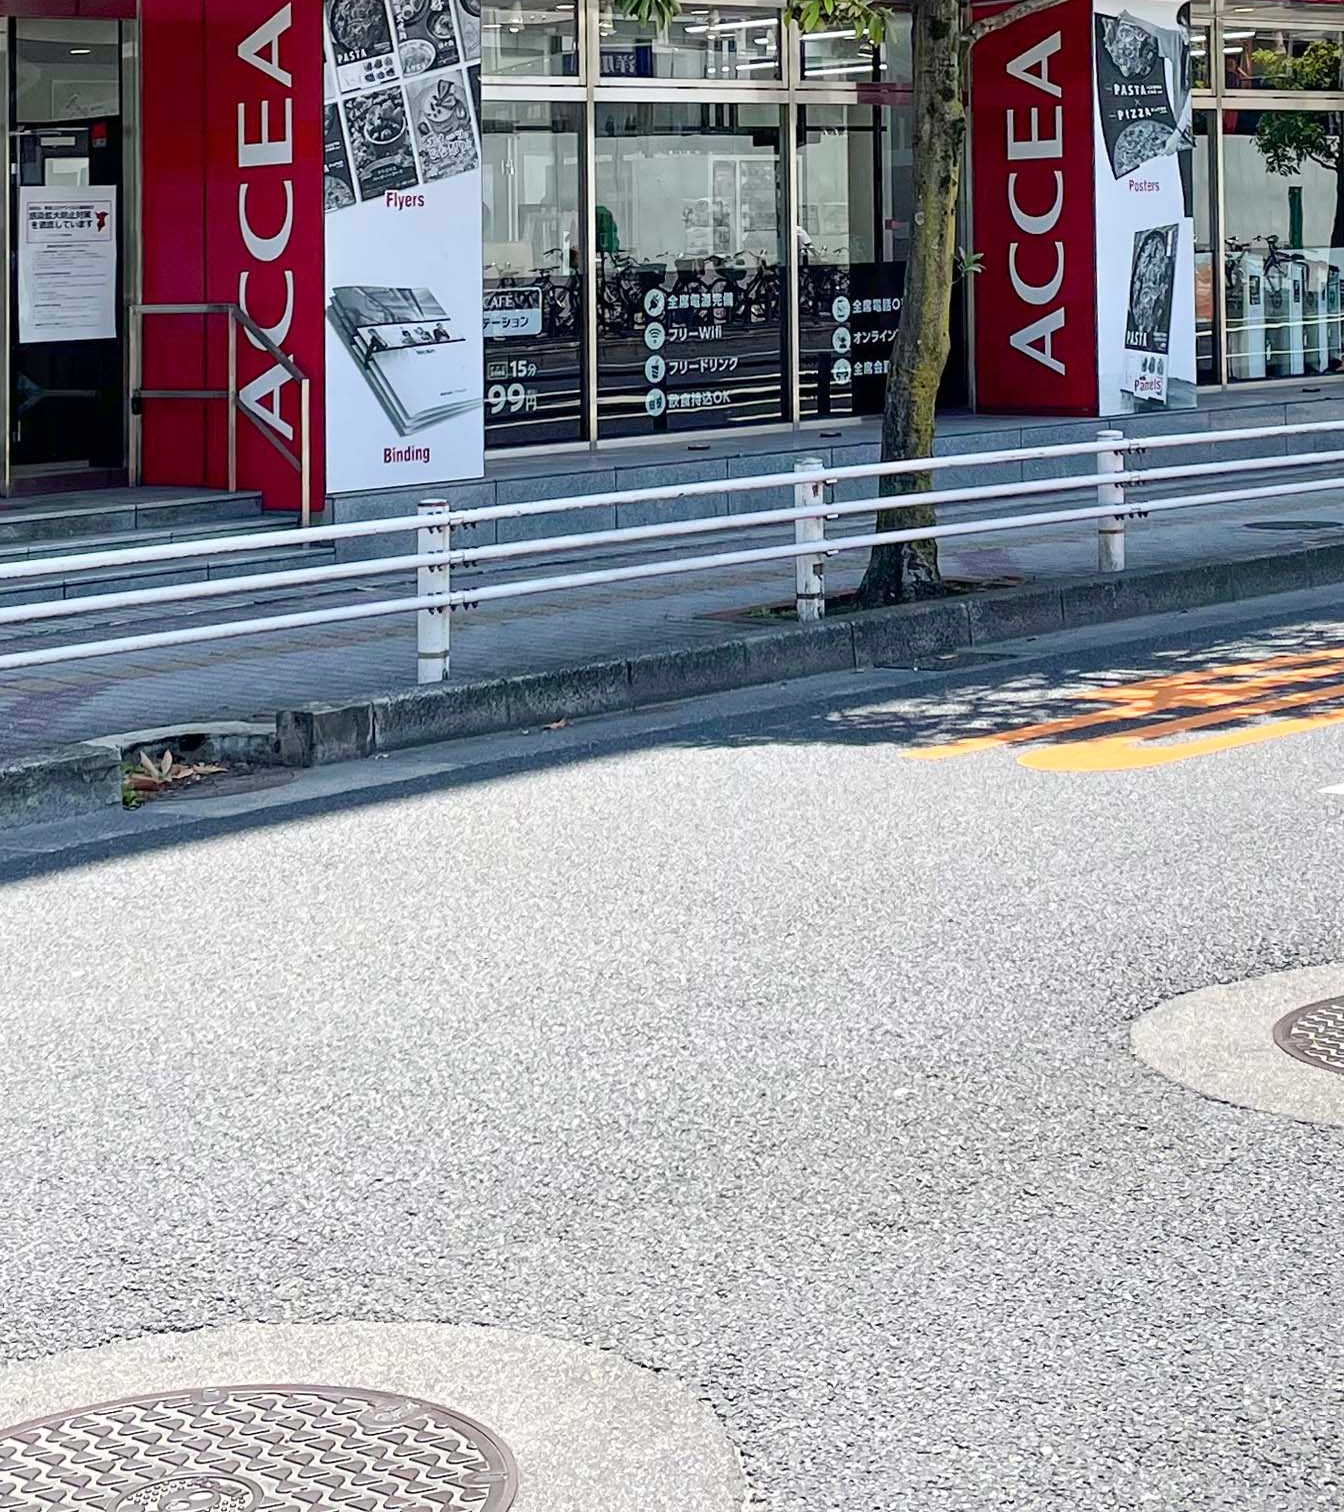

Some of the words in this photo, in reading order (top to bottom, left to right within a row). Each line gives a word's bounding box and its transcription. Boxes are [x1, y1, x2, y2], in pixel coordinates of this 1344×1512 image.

[337, 48, 368, 65] PASTA
[1128, 178, 1161, 193] Posters
[385, 190, 425, 214] Flyers
[1006, 30, 1066, 376] ACCEA
[237, 1, 294, 441] ACCEA
[852, 297, 904, 314] 全席電話O
[510, 360, 537, 377] 15分
[487, 383, 537, 415] 99円
[383, 443, 431, 466] Binding
